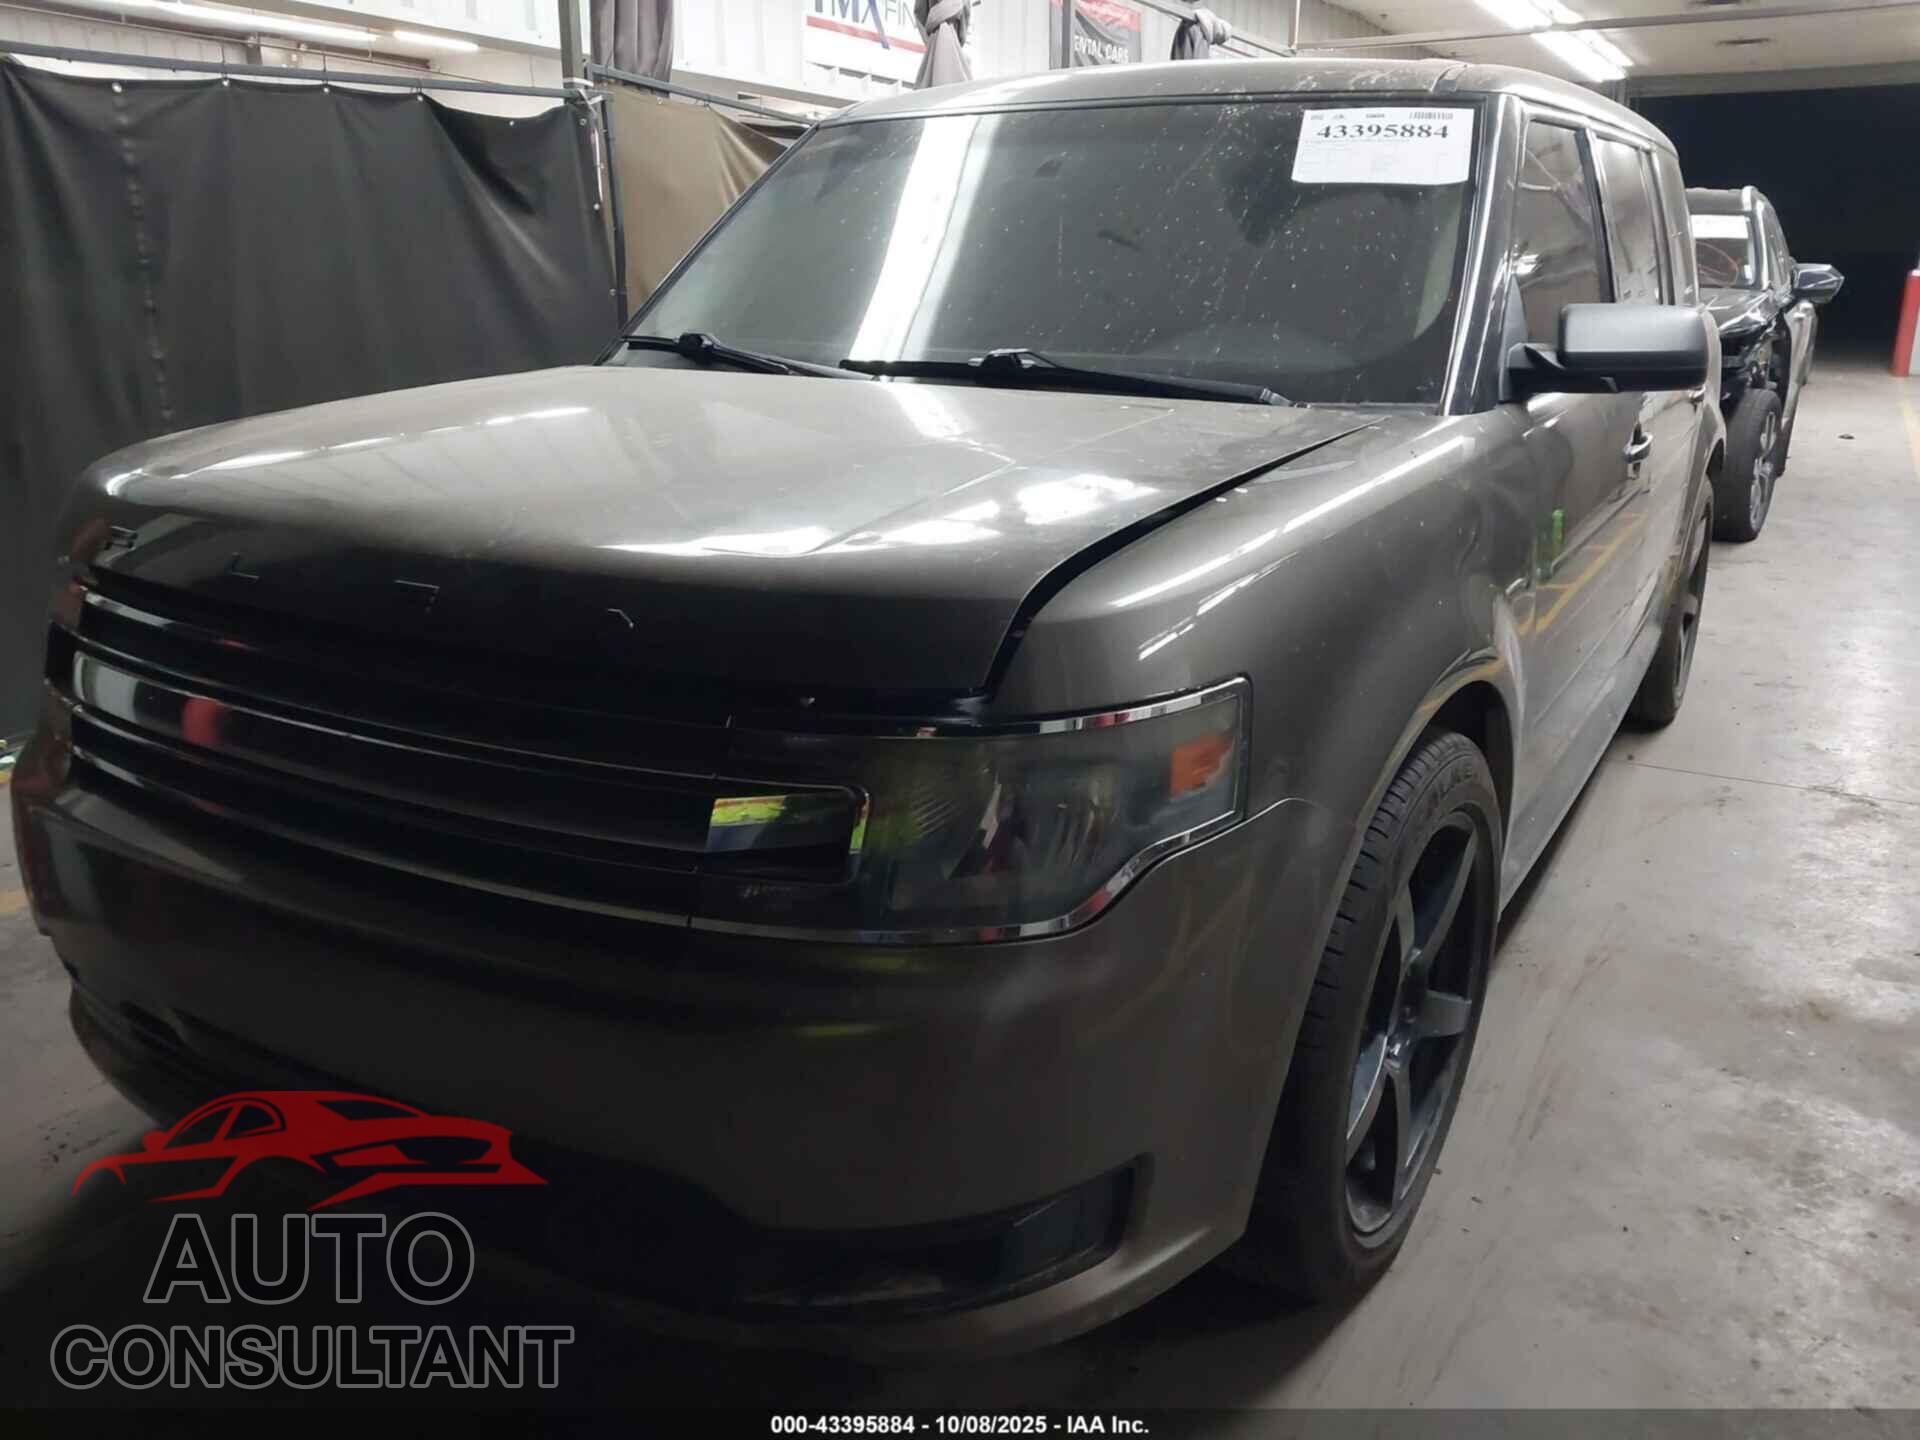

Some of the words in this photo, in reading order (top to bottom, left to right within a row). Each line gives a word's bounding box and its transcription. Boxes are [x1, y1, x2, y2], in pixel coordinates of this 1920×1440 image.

[1073, 35, 1103, 58] ENTAL
[1105, 43, 1129, 64] CARS
[1316, 124, 1449, 138] 43395884
